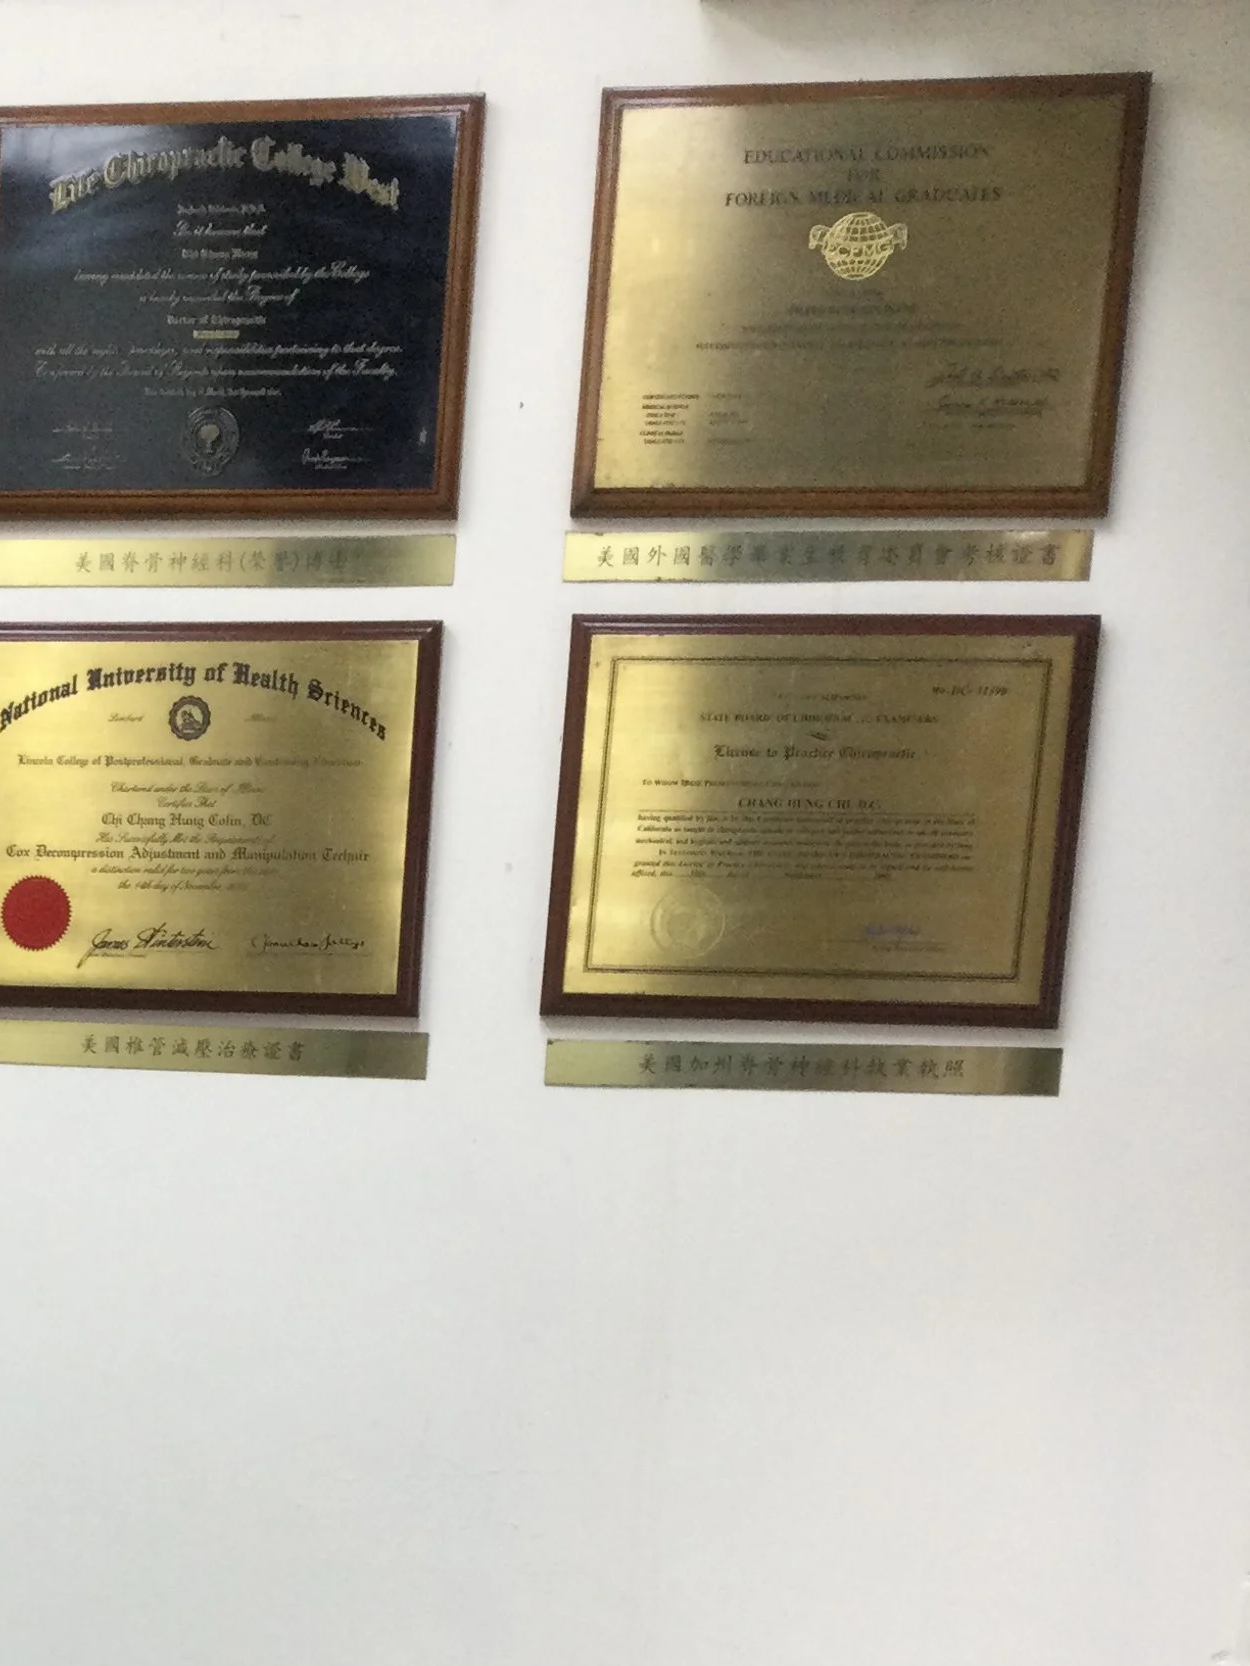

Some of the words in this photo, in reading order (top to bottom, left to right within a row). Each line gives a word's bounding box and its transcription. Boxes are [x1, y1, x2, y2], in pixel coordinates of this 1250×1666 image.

[743, 147, 864, 165] EDUCATIONAL
[871, 144, 990, 162] COMMISSION
[725, 190, 799, 207] FOREIGN
[894, 186, 1002, 204] GRADUATES
[86, 662, 197, 692] University
[203, 661, 229, 683] of
[232, 661, 300, 699] Health
[306, 678, 387, 742] Sciences
[56, 755, 90, 769] College
[91, 754, 102, 767] of
[100, 812, 124, 829] Chi
[126, 812, 167, 830] Chang
[169, 812, 205, 830] Hung
[4, 843, 31, 859] Cox
[34, 843, 125, 862] Decompression
[128, 844, 201, 863] Adjustment
[203, 847, 227, 861] and
[229, 846, 317, 865] Manipulation
